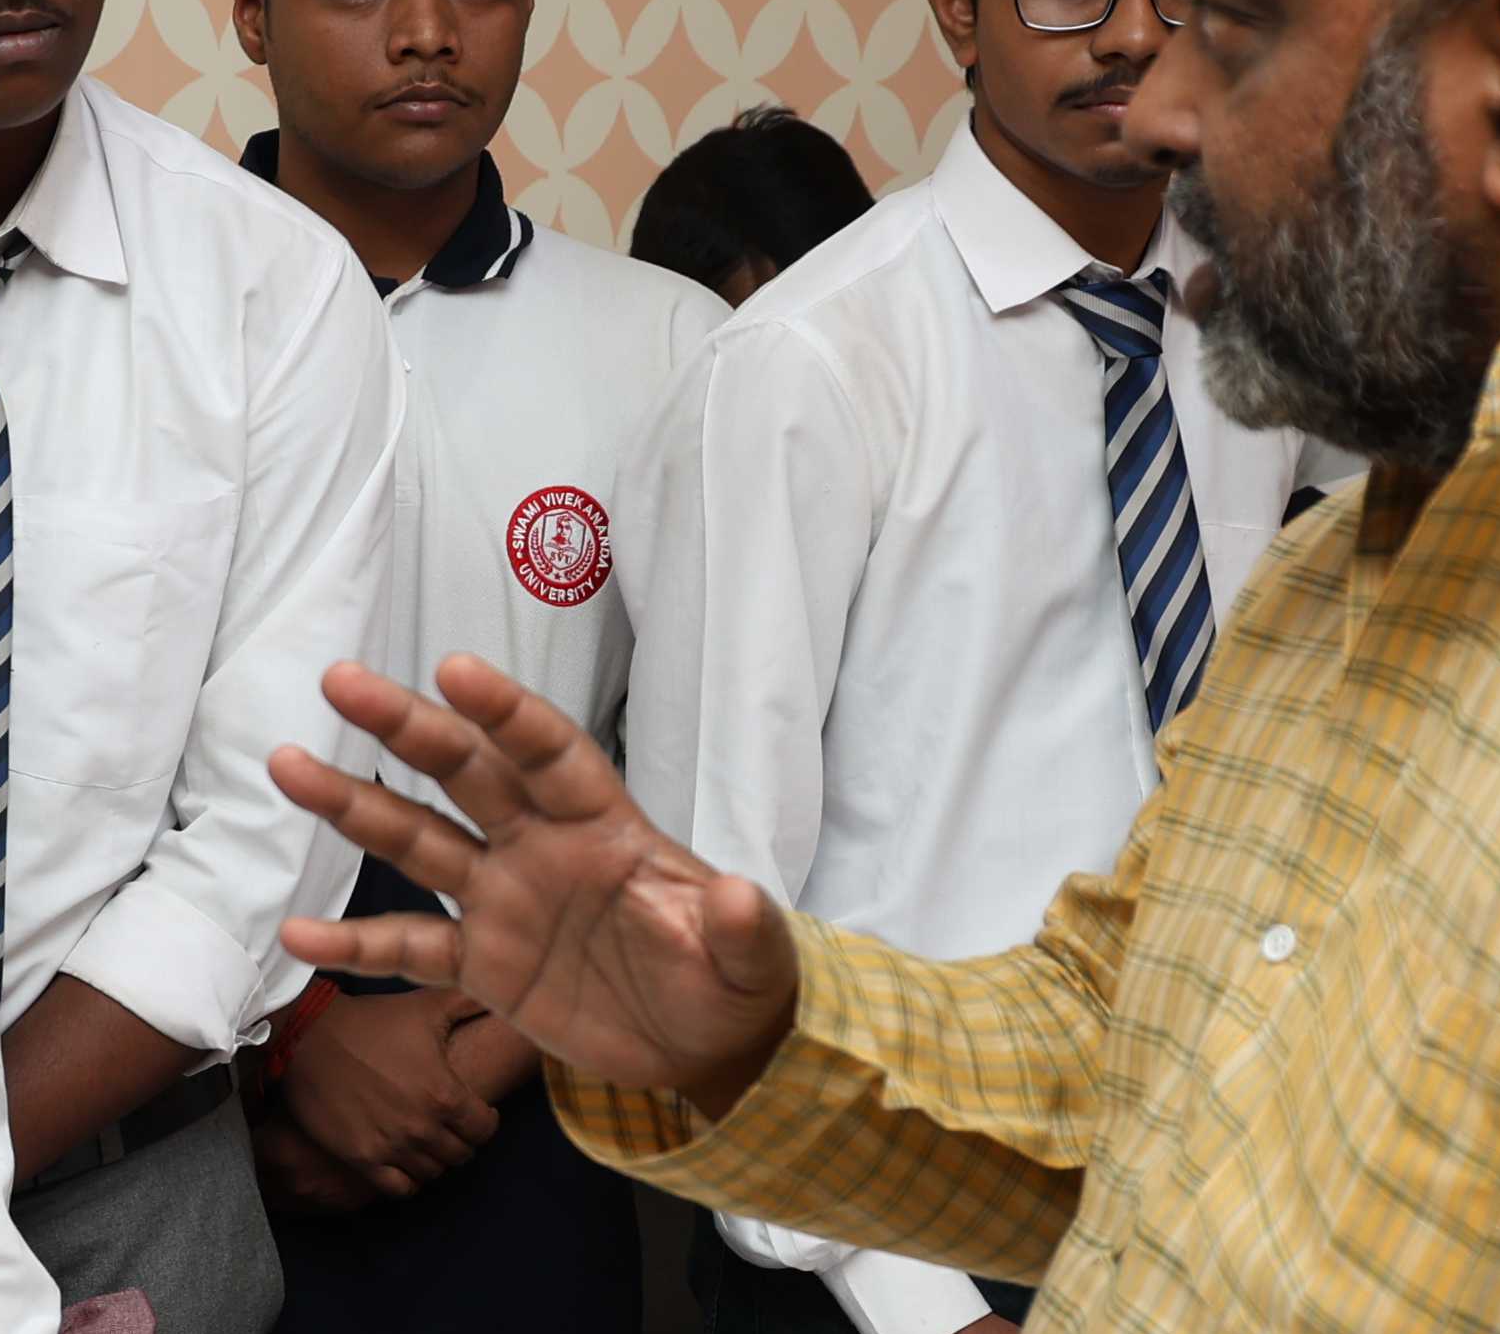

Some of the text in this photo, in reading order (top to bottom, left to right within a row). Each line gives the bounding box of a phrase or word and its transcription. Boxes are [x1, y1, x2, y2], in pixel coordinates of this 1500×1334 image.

[512, 492, 610, 568] SWAMI VIVEKANANDA
[519, 562, 595, 602] UNIVERSITY
